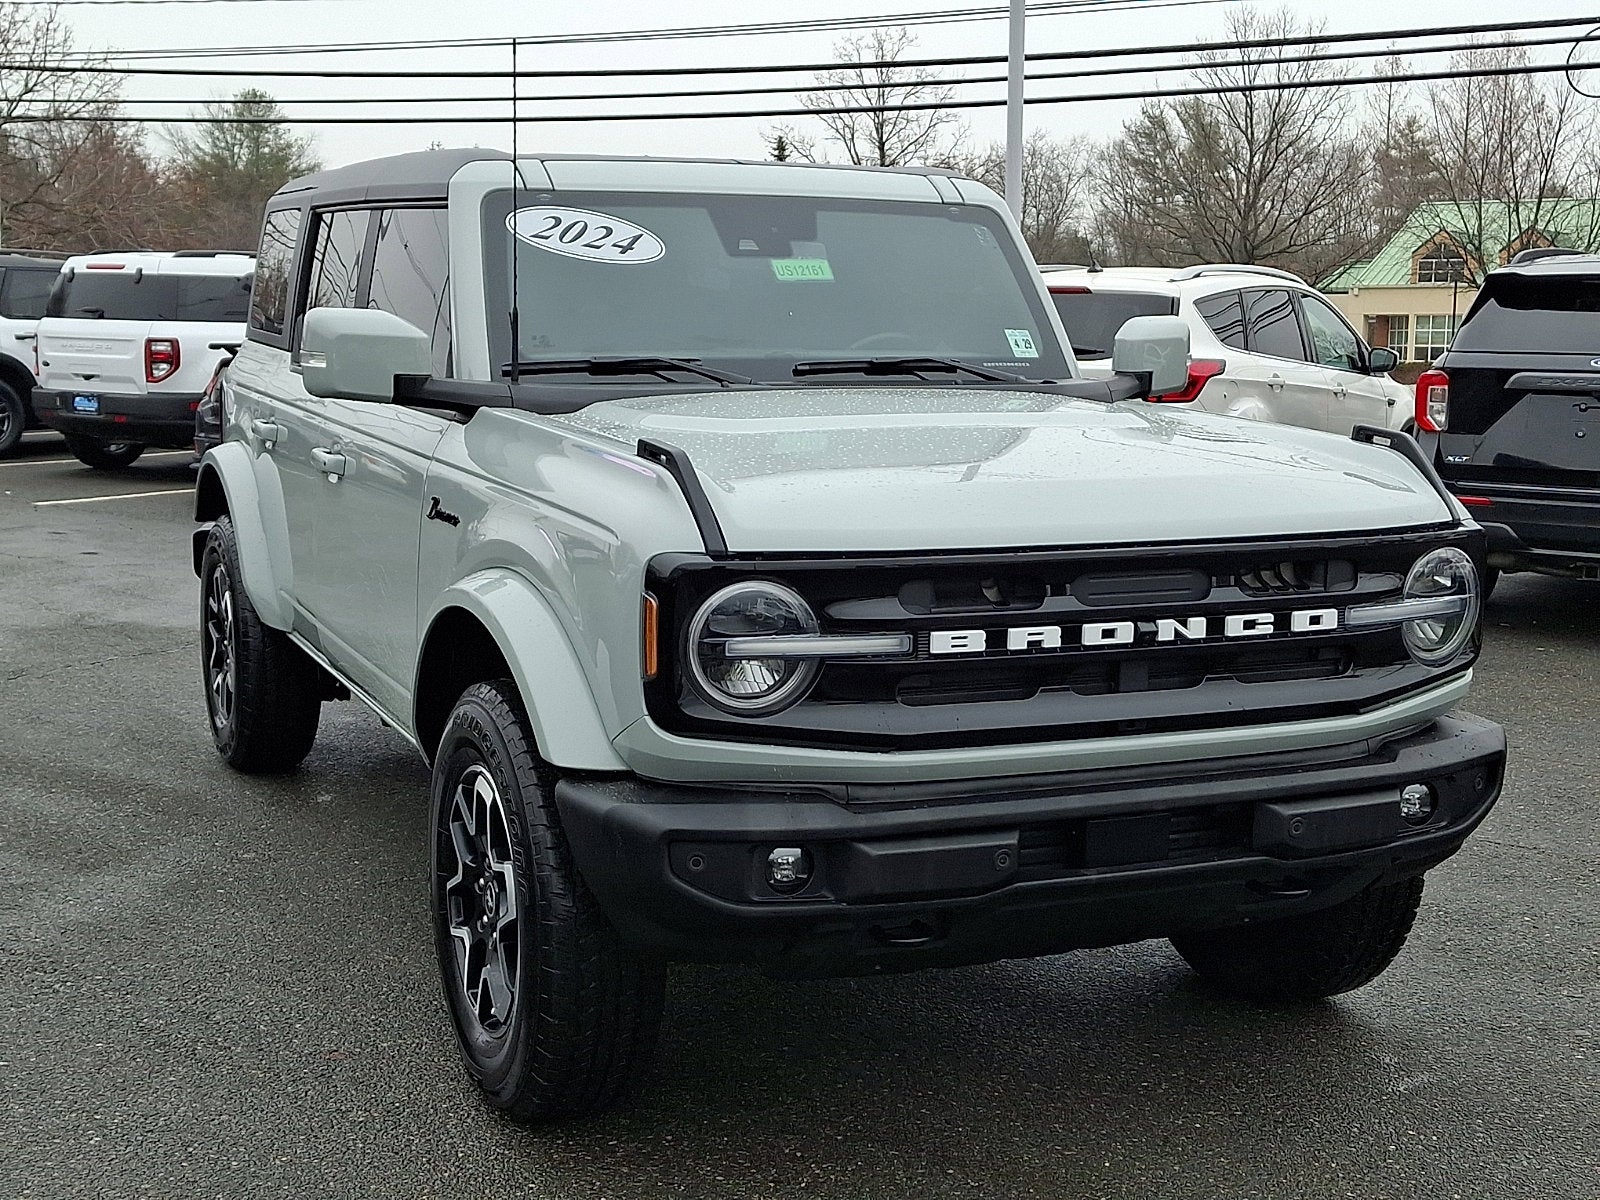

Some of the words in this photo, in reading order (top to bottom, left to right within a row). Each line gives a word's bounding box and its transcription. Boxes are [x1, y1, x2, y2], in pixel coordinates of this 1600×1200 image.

[528, 215, 644, 255] 2024
[775, 264, 825, 277] US12161
[930, 608, 1338, 654] BRONCO
